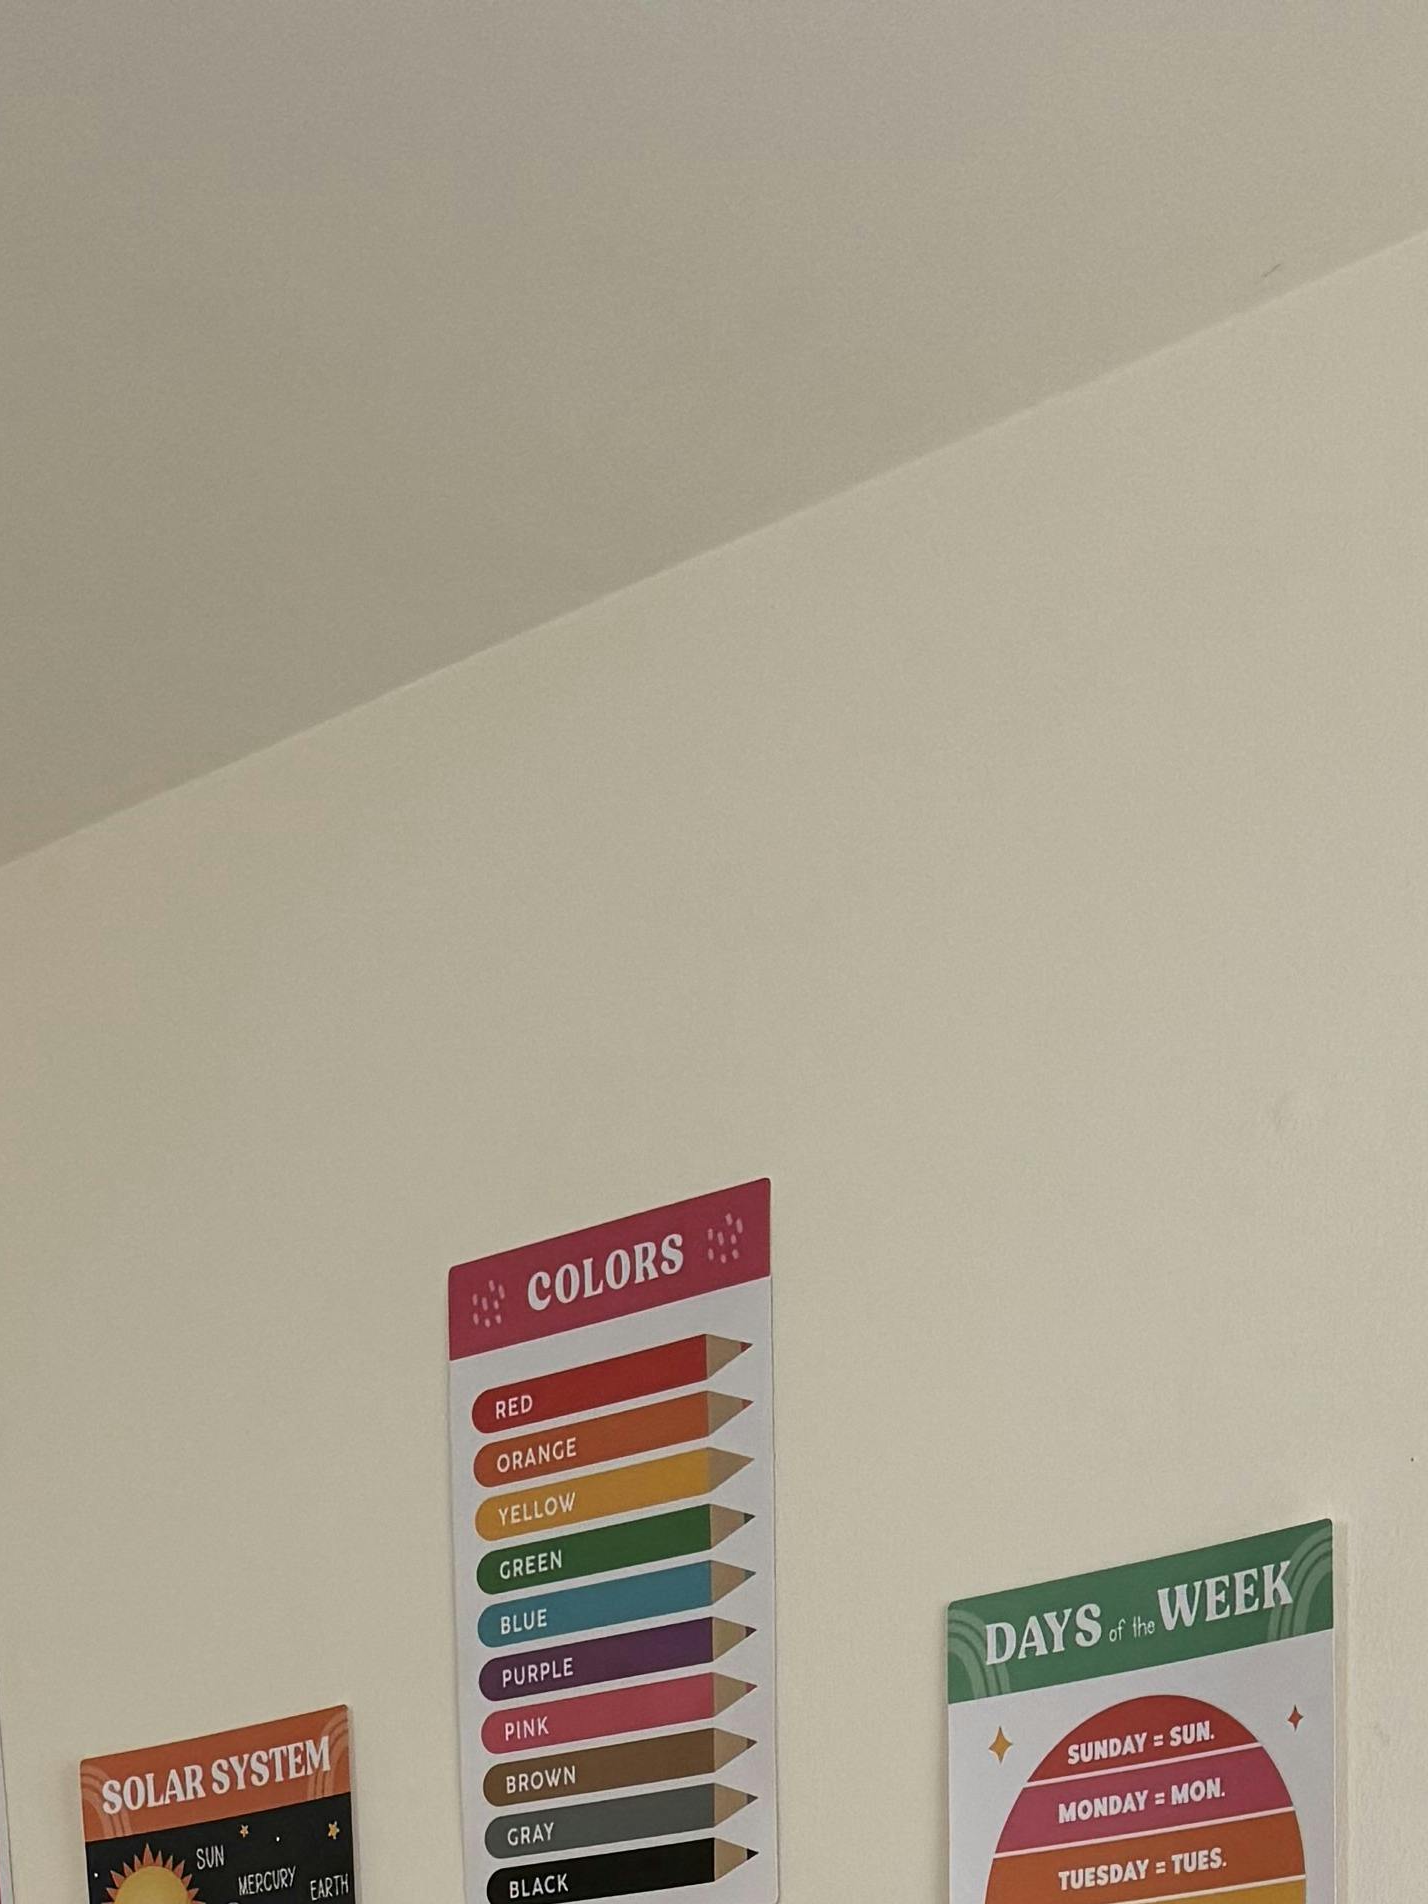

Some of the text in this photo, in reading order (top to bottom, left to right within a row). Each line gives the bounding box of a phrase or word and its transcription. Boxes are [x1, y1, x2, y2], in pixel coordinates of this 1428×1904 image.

[527, 1233, 684, 1311] COLORS
[495, 1394, 533, 1420] RED
[496, 1436, 577, 1473] ORANGE
[497, 1491, 576, 1527] YELLOW
[499, 1549, 562, 1580] GREEN
[500, 1608, 548, 1635] BLUE
[984, 1559, 1294, 1667] DAYS of the WEEK
[502, 1657, 574, 1688] PURPLE
[504, 1716, 549, 1742] PINK
[1067, 1732, 1148, 1765] SUNDAY
[1169, 1720, 1215, 1747] SUN.
[101, 1735, 331, 1815] SOLAR SYSTEM
[505, 1765, 576, 1794] BROWN
[1058, 1789, 1149, 1824] MONDAY
[1171, 1777, 1226, 1806] MON.
[507, 1821, 555, 1846] GRAY
[195, 1844, 225, 1870] SUN
[1057, 1858, 1150, 1891] TUESDAY
[1170, 1847, 1227, 1875] TUES.
[238, 1865, 296, 1896] MERCURY
[309, 1873, 349, 1901] EARTH
[509, 1872, 569, 1899] BLACK
